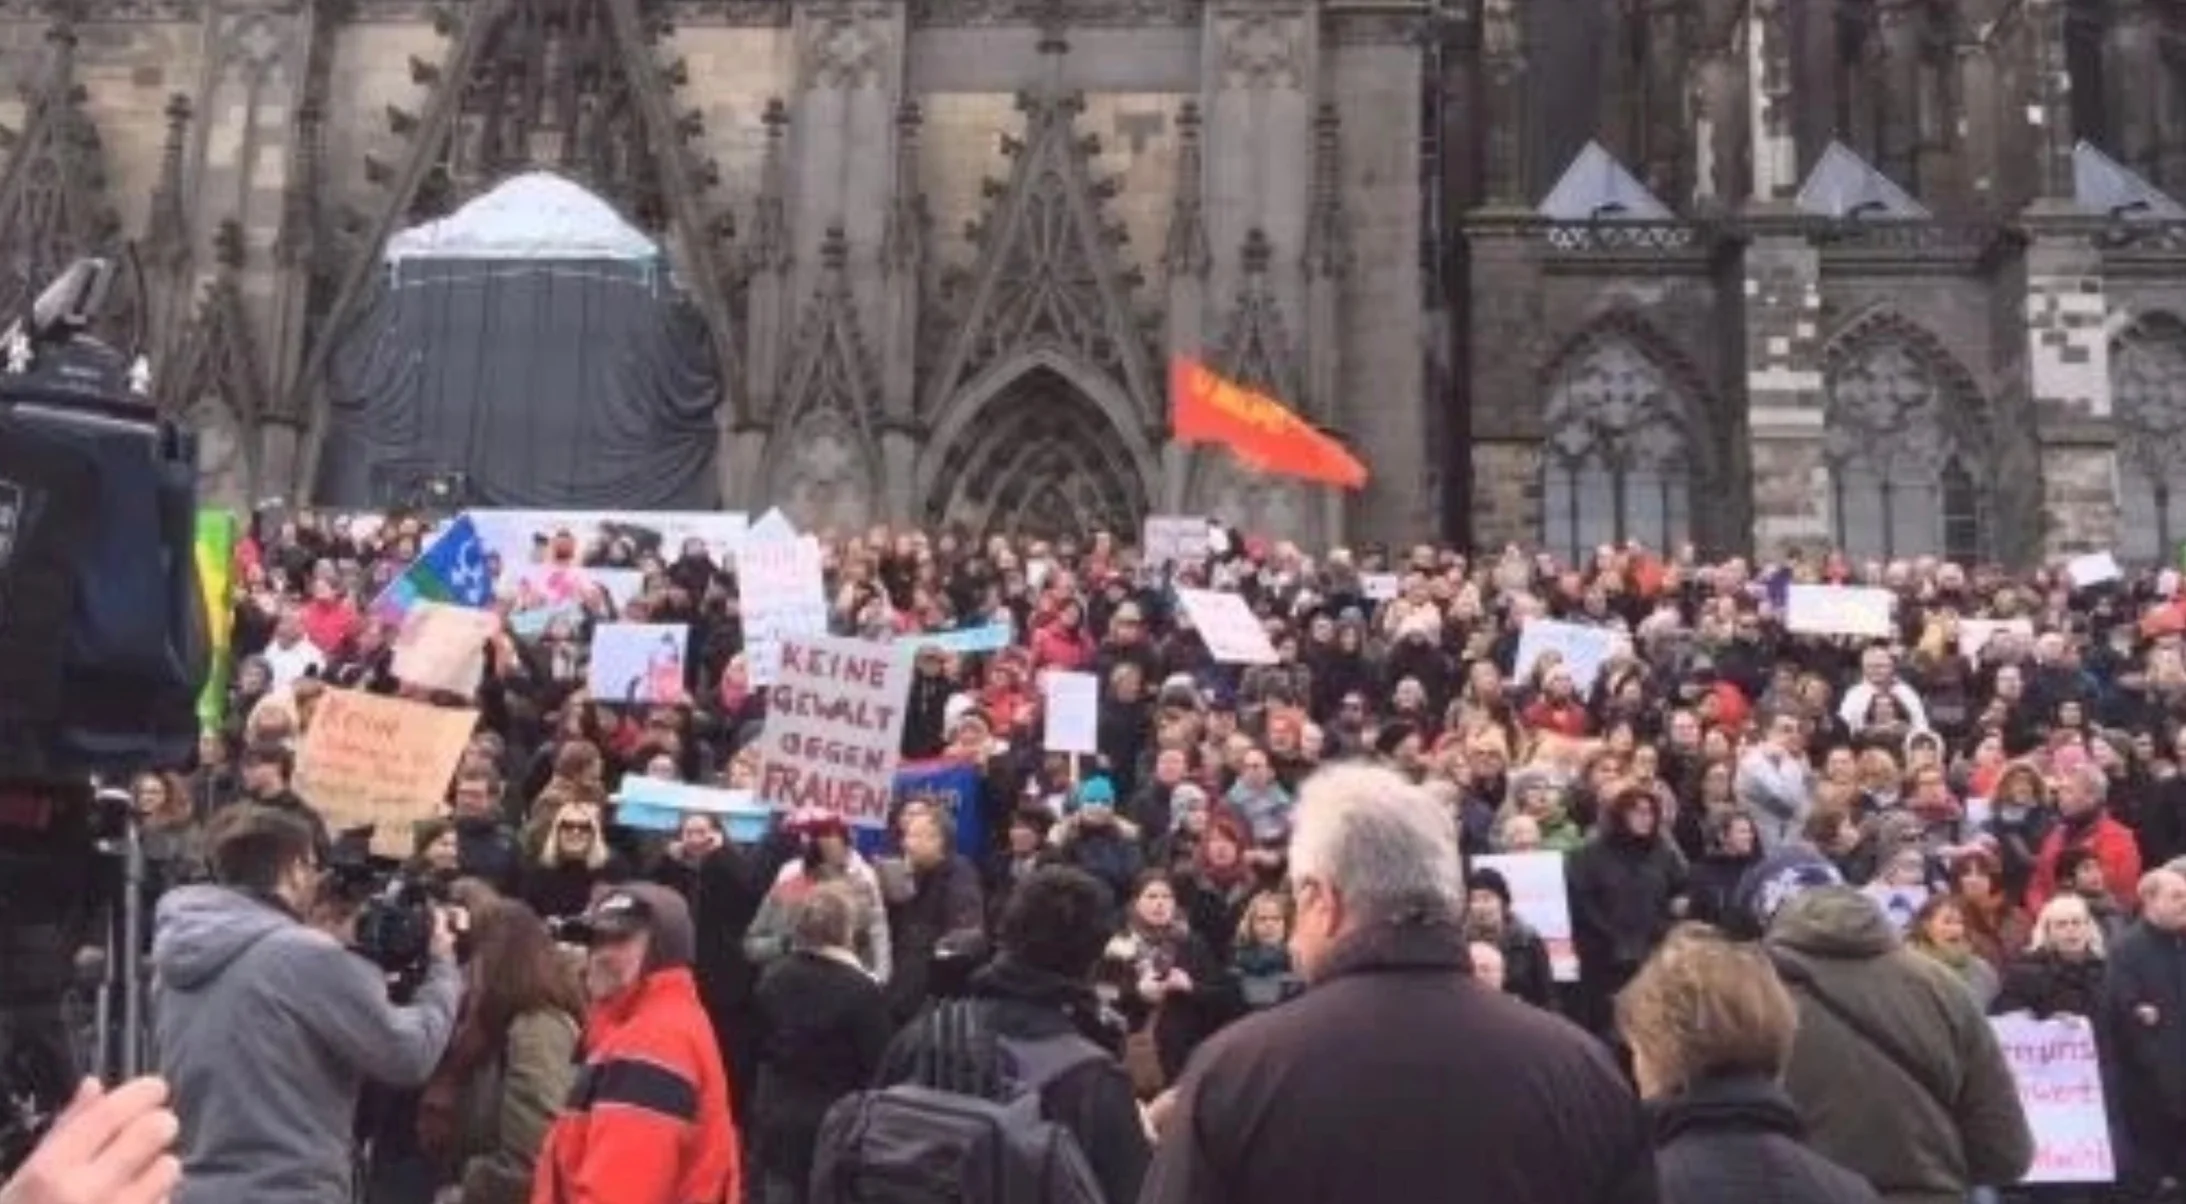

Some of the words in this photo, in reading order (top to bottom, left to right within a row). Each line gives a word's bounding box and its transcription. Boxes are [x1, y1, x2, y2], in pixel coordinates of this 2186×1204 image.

[781, 640, 888, 688] KEINE
[773, 685, 895, 731] GEWALT
[762, 762, 887, 817] FRAUEN
